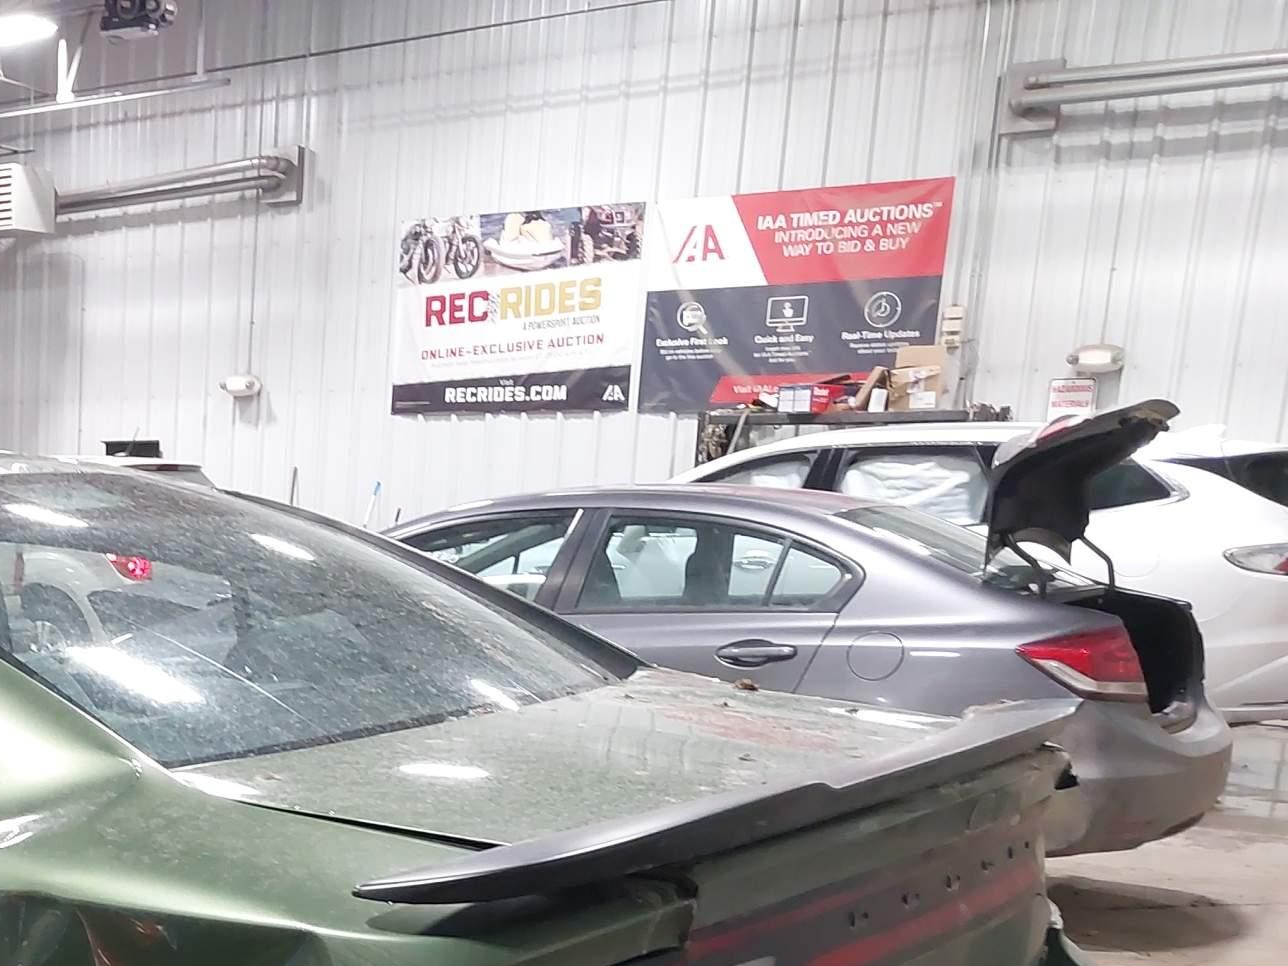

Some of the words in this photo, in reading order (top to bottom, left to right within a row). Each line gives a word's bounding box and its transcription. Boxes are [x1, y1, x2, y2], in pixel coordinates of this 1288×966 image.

[757, 213, 787, 231] IAA
[790, 209, 840, 228] TIMED
[774, 222, 869, 244] INTRODUCING
[871, 222, 884, 237] A
[887, 220, 921, 236] NEW
[782, 241, 814, 257] WAY
[815, 240, 835, 255] TO
[838, 238, 861, 253] BID
[863, 238, 876, 251] &
[879, 237, 910, 250] BUY
[425, 290, 490, 328] REC
[499, 277, 603, 321] RIDES
[421, 339, 544, 361] ONLINE-EXCLUSIVE
[547, 333, 605, 349] AUCTION
[444, 384, 568, 403] RECRIDES.COM
